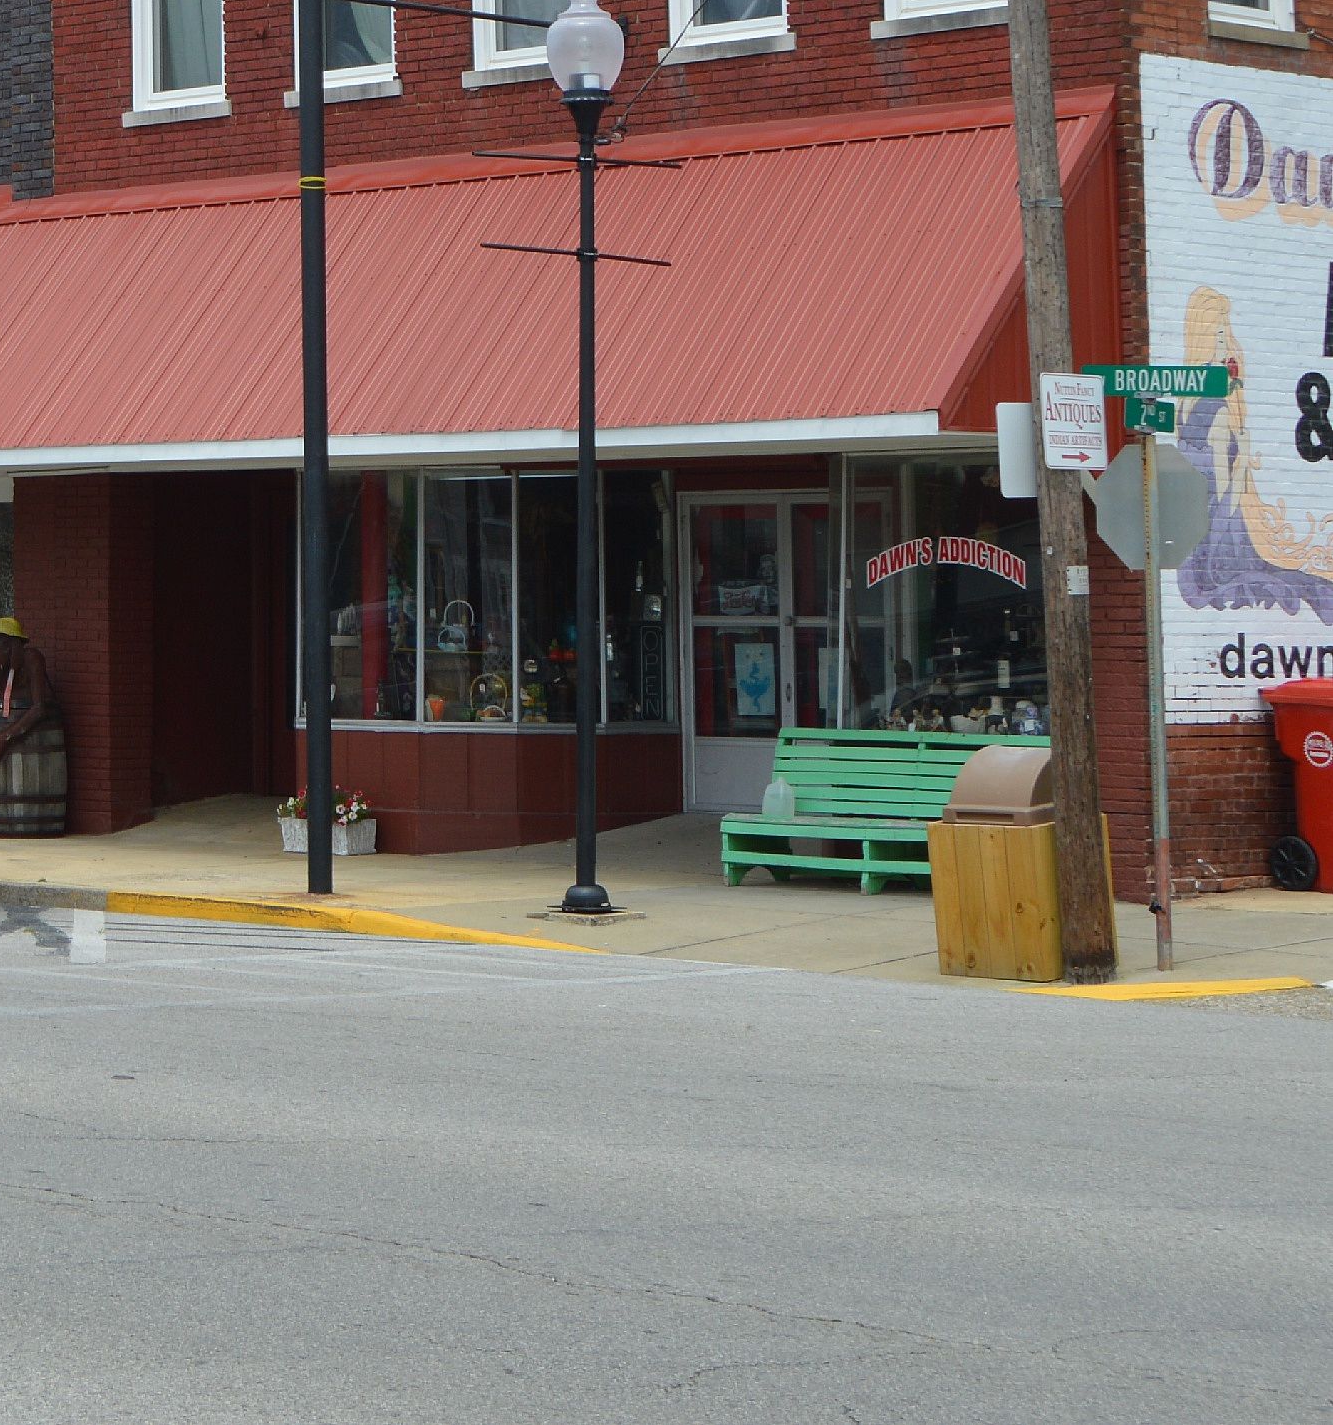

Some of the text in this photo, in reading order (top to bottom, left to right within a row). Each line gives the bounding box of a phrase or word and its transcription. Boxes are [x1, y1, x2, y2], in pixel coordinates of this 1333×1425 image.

[1188, 98, 1333, 211] Da
[1114, 369, 1208, 392] BROADWAY
[1045, 391, 1102, 430] ANTIQUES
[866, 536, 1027, 590] DAWN'S ADDICTION
[643, 630, 660, 718] OPEN
